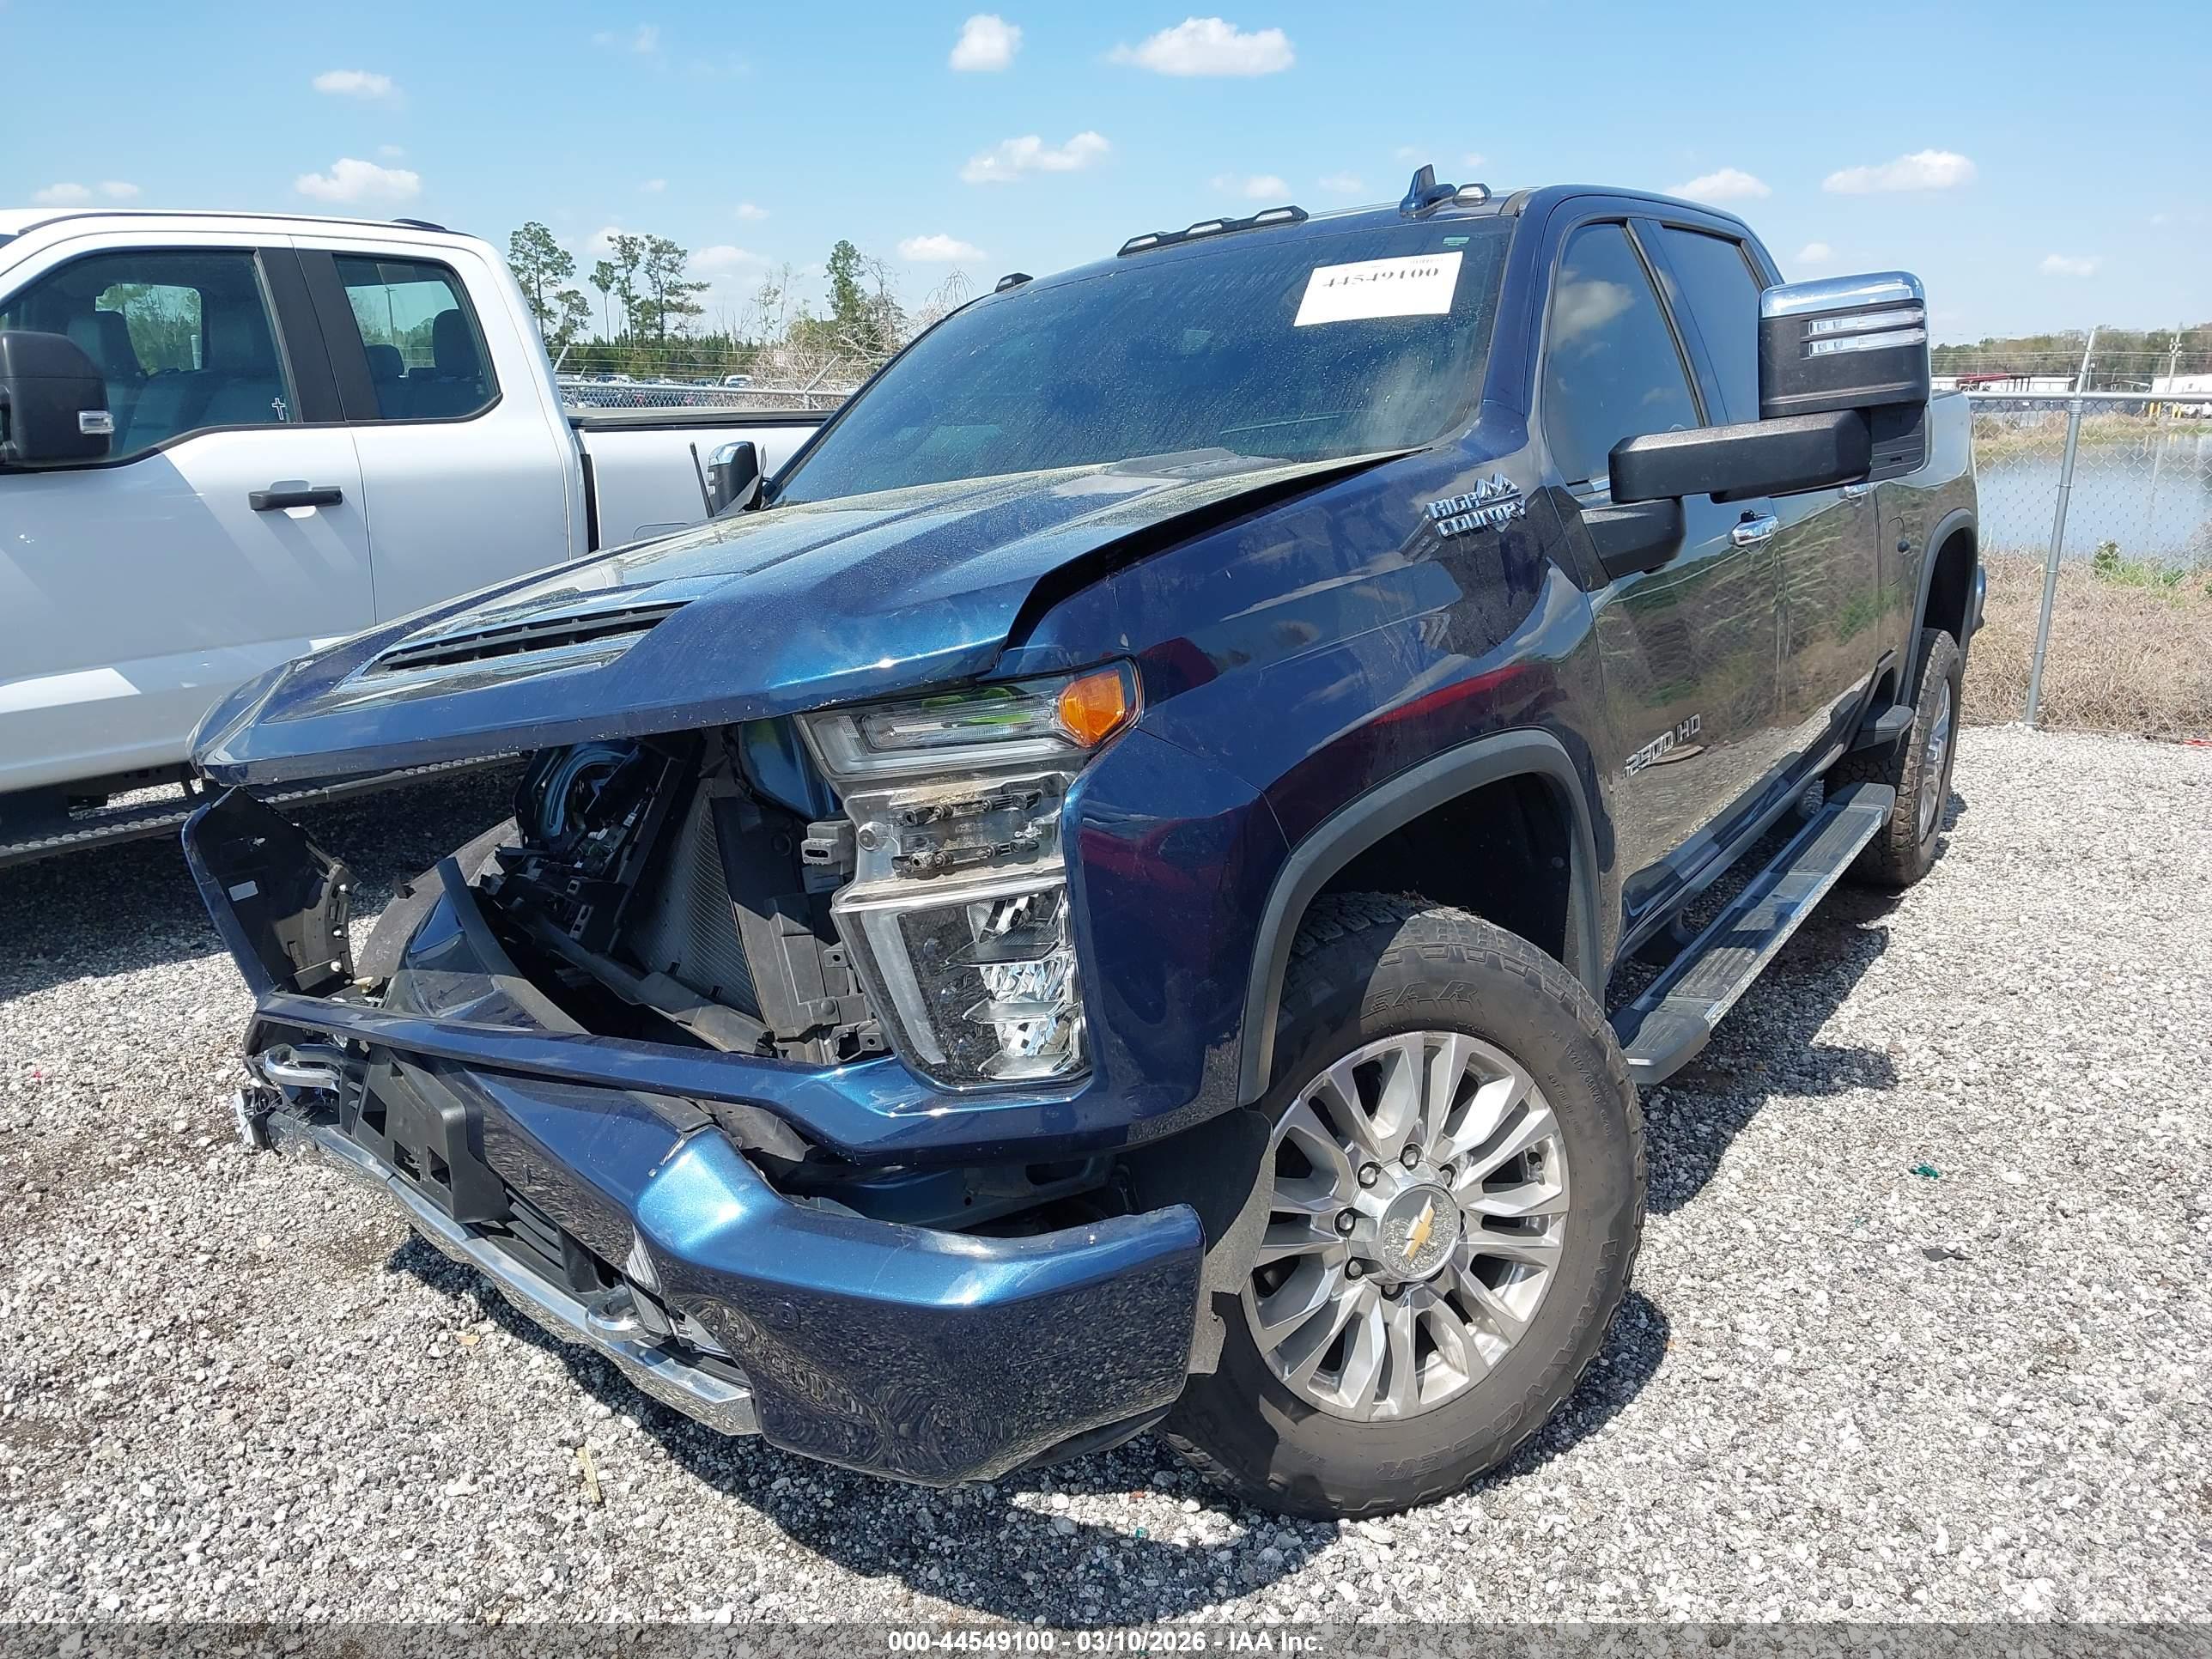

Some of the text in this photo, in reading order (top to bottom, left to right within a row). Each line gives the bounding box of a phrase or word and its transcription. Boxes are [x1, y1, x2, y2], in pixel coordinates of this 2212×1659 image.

[1425, 491, 1481, 519] HIGH
[1436, 500, 1526, 538] COUNTRY
[1624, 713, 1701, 777] 2500 HD
